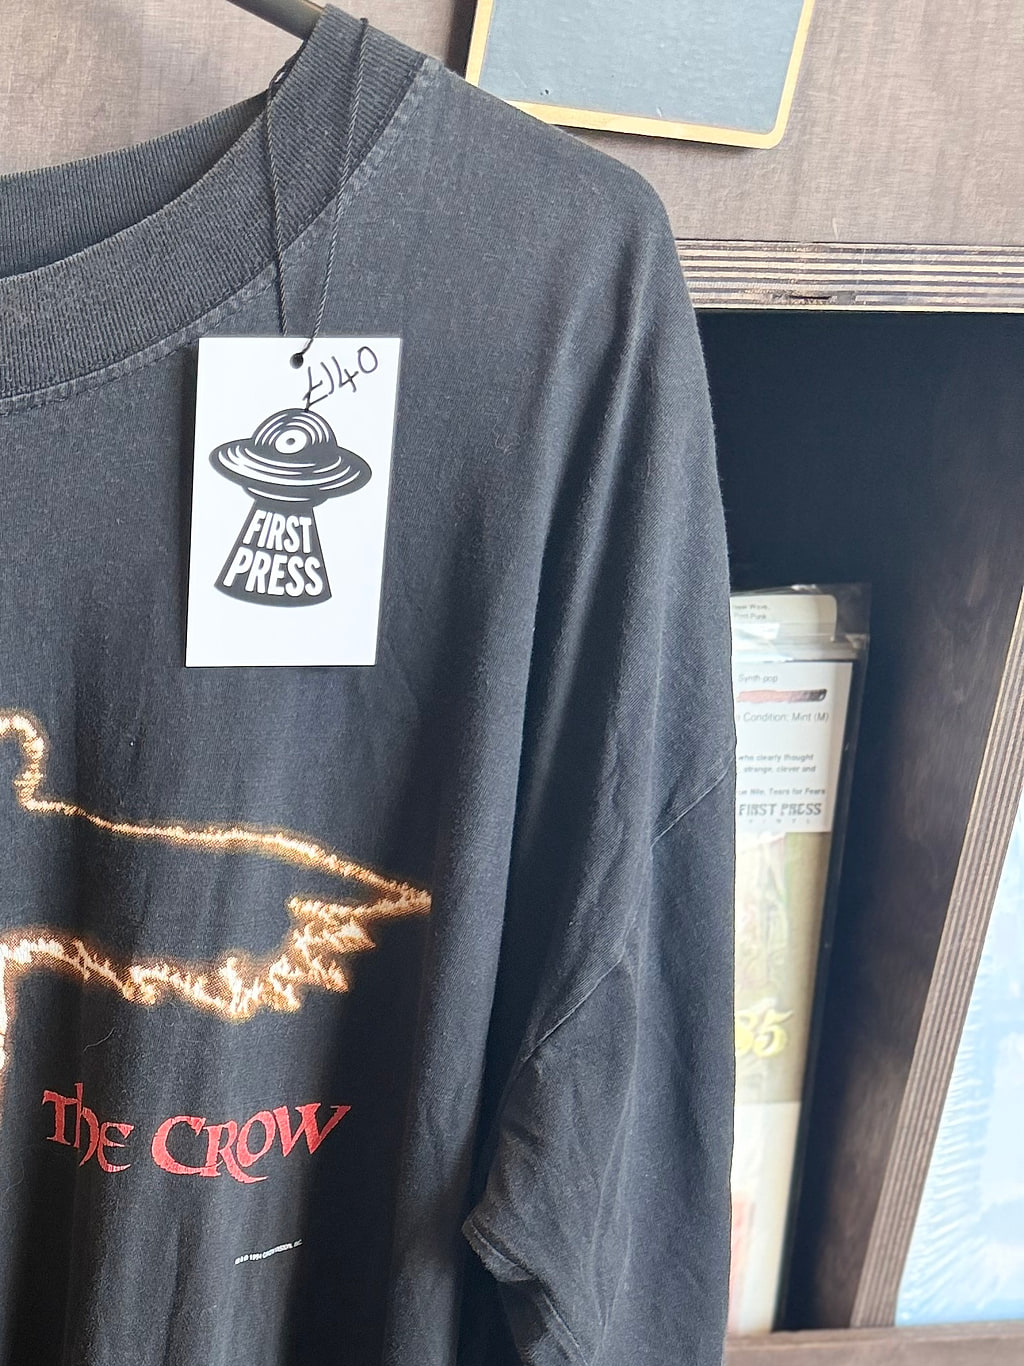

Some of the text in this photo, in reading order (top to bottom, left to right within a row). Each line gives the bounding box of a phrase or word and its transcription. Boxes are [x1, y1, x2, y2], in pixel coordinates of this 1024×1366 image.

[302, 346, 379, 411] £140
[241, 509, 312, 554] FIRST
[223, 546, 324, 598] PRESS
[738, 802, 823, 817] FIRST PRESS
[150, 1101, 353, 1184] CROW
